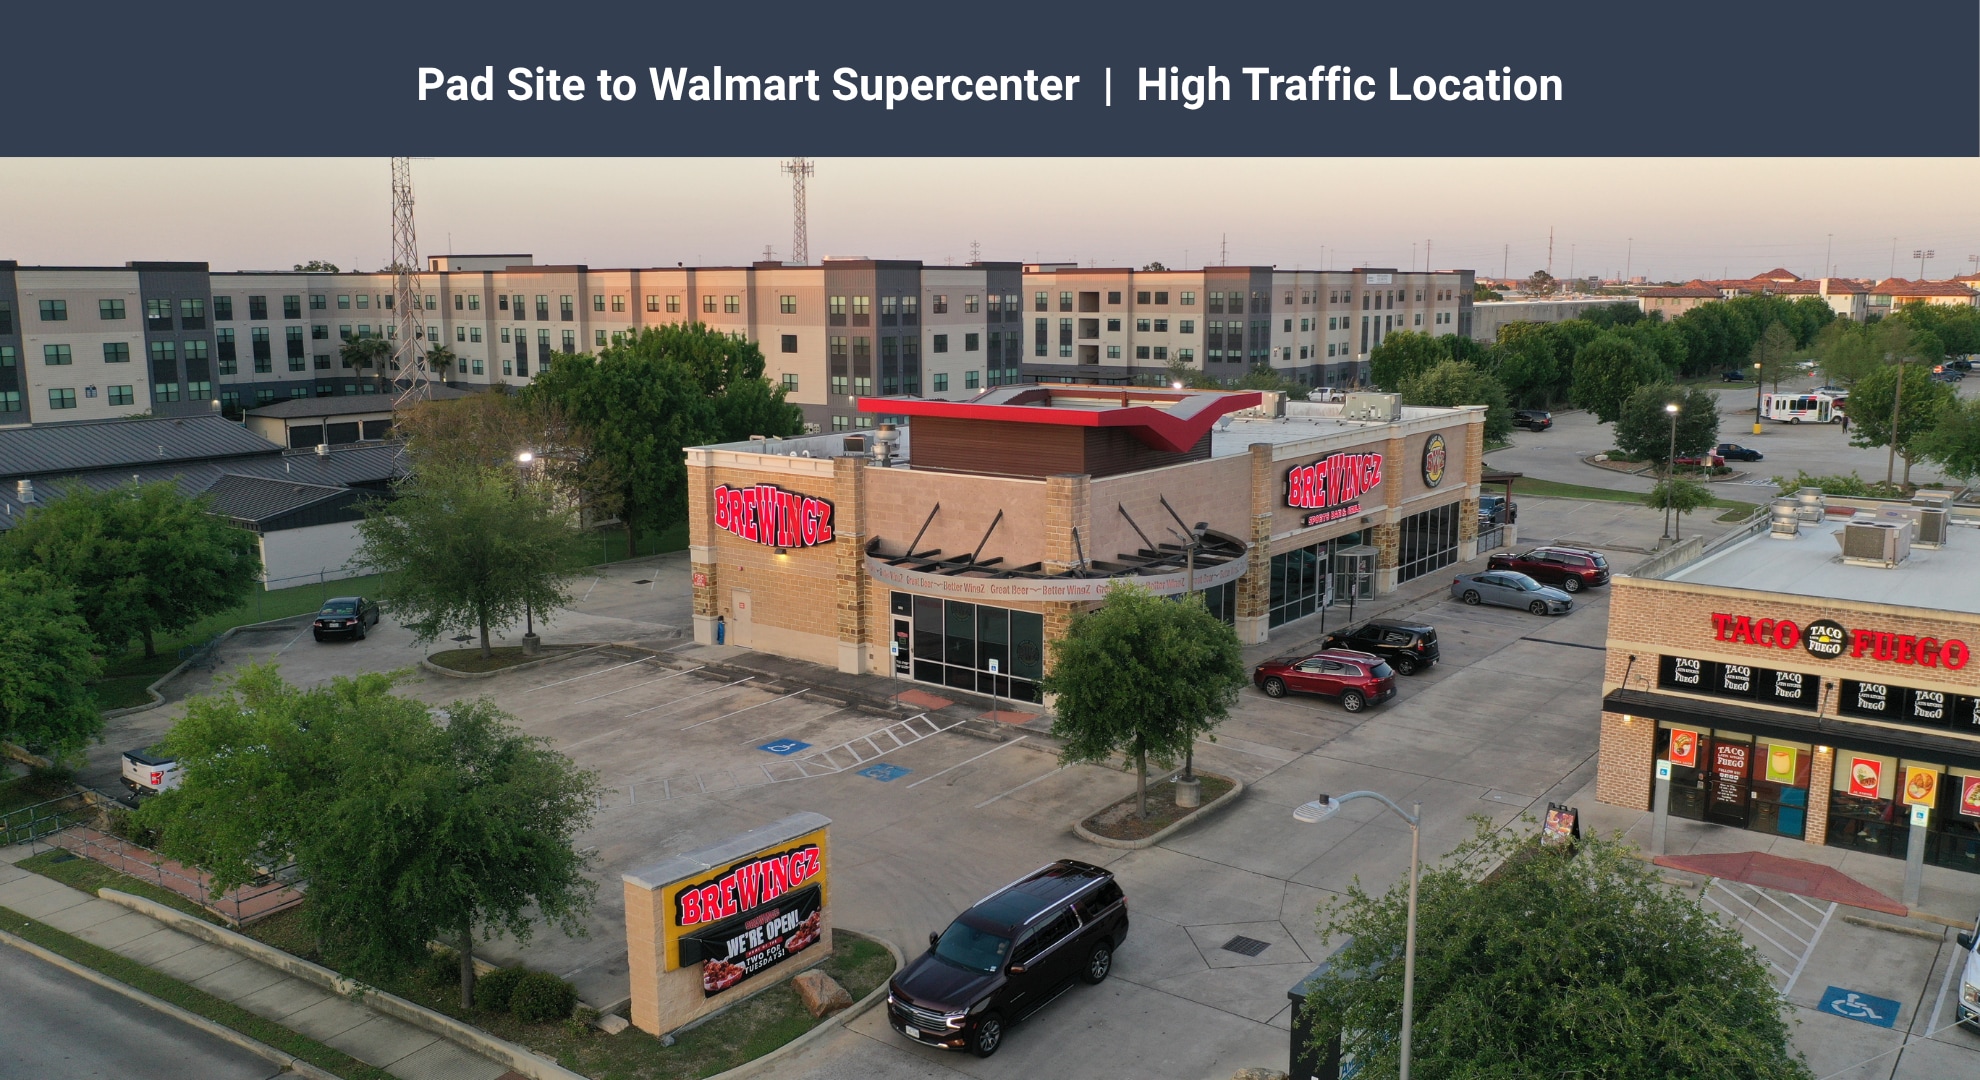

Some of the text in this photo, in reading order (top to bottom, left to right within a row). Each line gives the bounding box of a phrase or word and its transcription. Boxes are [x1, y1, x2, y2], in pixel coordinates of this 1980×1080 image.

[1288, 453, 1382, 508] BREWINGZ
[714, 485, 832, 547] BREWINGZ
[1308, 512, 1330, 525] SPORTS
[943, 581, 963, 592] Better
[991, 585, 1009, 594] Great
[1012, 585, 1028, 595] Beer
[1042, 585, 1065, 595] Better
[1067, 585, 1090, 594] WingZ
[1810, 626, 1842, 639] TACO
[1711, 612, 1970, 670] TACO FUEGO
[1808, 640, 1841, 654] FUEGO
[1675, 658, 1700, 670] TACO
[1725, 664, 1750, 677] TACO
[1675, 671, 1699, 684] FUEGO
[1724, 678, 1749, 691] FUEGO
[1776, 671, 1802, 684] TACO
[1775, 685, 1801, 698] FUEGO
[1859, 682, 1887, 696] TACO
[1915, 690, 1944, 703] TACO
[1857, 697, 1886, 711] FUEGO
[1914, 704, 1943, 719] FUEGO
[1718, 746, 1745, 757] TACO
[1717, 757, 1744, 768] FUEGO
[681, 847, 820, 925] BREWINGZ
[726, 926, 765, 958] WE'RE
[766, 909, 799, 940] OPEN!
[745, 948, 785, 974] TUESDAYS!
[746, 952, 764, 966] TWO
[766, 944, 781, 957] FOR
